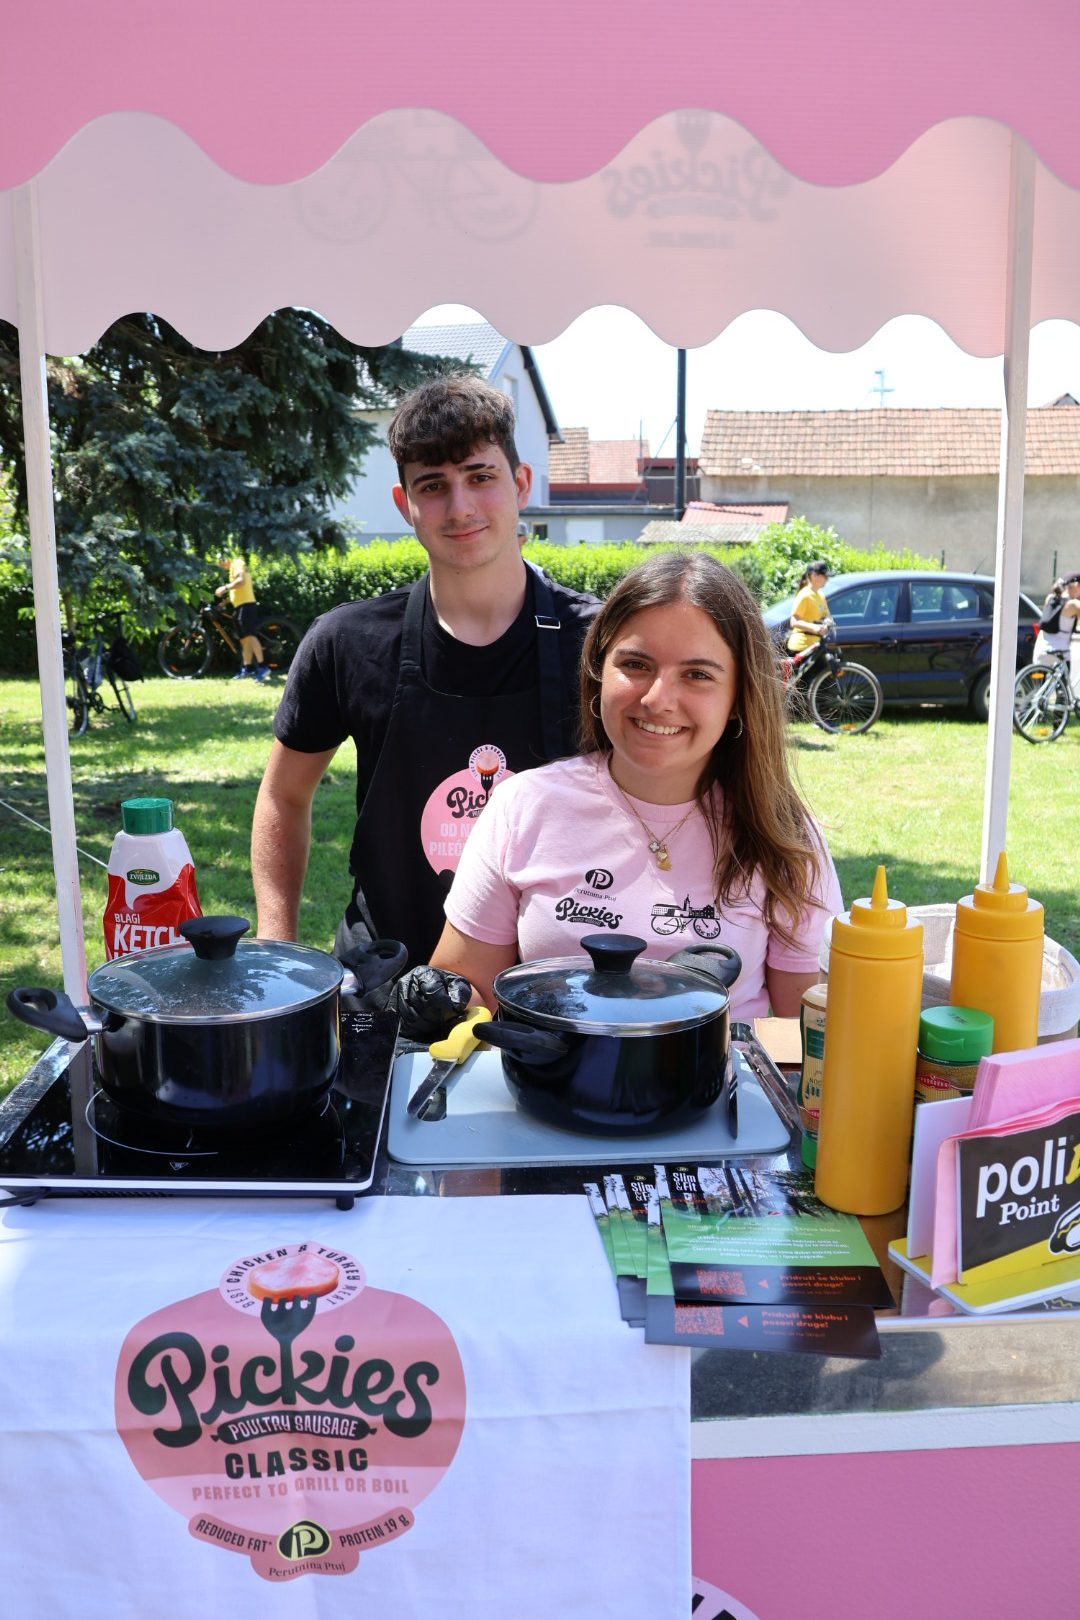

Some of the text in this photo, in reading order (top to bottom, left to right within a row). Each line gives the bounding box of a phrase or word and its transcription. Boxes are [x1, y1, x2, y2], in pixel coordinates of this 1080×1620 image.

[114, 912, 140, 923] BLAGI
[555, 897, 623, 929] Pickies
[673, 1172, 697, 1183] Slim
[682, 1182, 698, 1191] Fit
[999, 1194, 1060, 1226] Point
[226, 1248, 288, 1284] CHICKEN
[317, 1247, 361, 1281] TURKEY
[226, 1287, 255, 1309] BEST
[326, 1284, 358, 1305] MEAT
[127, 1331, 440, 1447] Pickies
[229, 1413, 358, 1440] POULTRY SAUSAGE
[225, 1447, 369, 1479] CLASSIC
[192, 1476, 409, 1501] PERFECT TO GRILL OR BOIL
[195, 1519, 245, 1547] REDUCED
[339, 1514, 410, 1547] PROTEIN 19 g
[268, 1562, 346, 1577] Perutnina Ptuj
